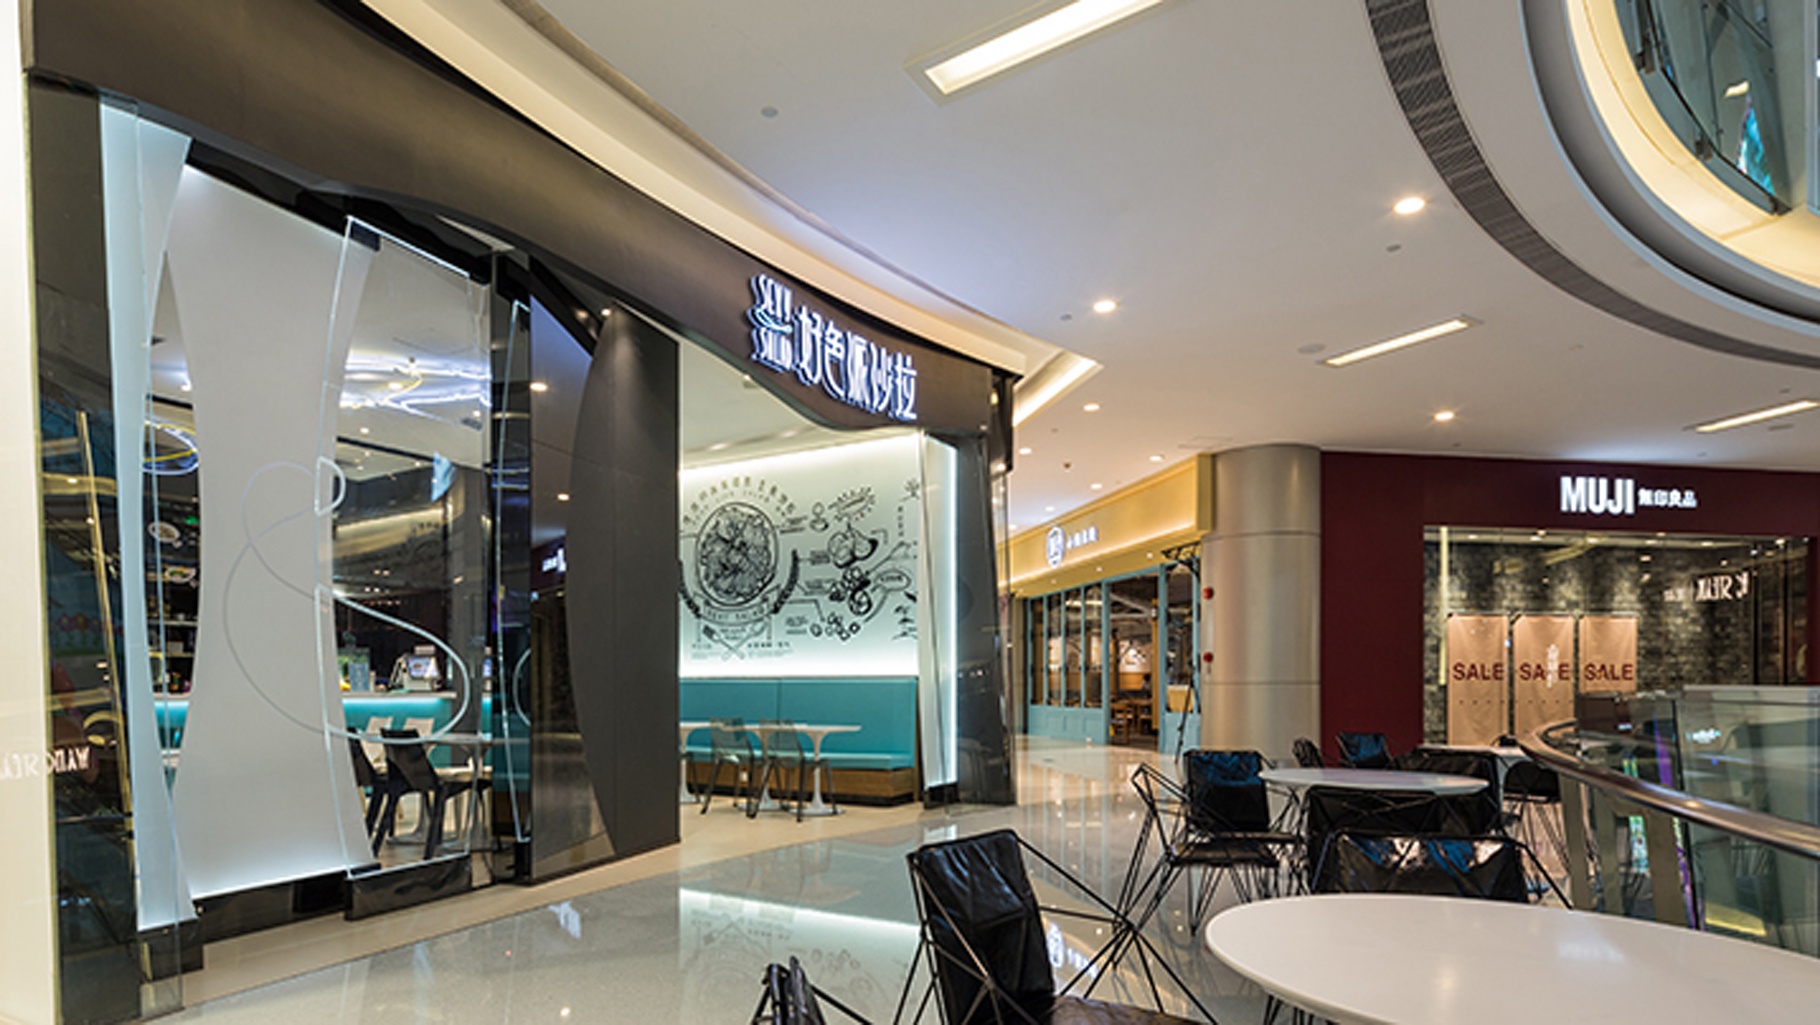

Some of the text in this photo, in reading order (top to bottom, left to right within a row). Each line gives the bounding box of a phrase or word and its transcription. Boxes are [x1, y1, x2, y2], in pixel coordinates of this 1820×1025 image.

[1560, 476, 1635, 515] MUJI
[1453, 663, 1504, 681] SALE
[1519, 663, 1570, 681] SAE
[1584, 663, 1633, 681] SALE
